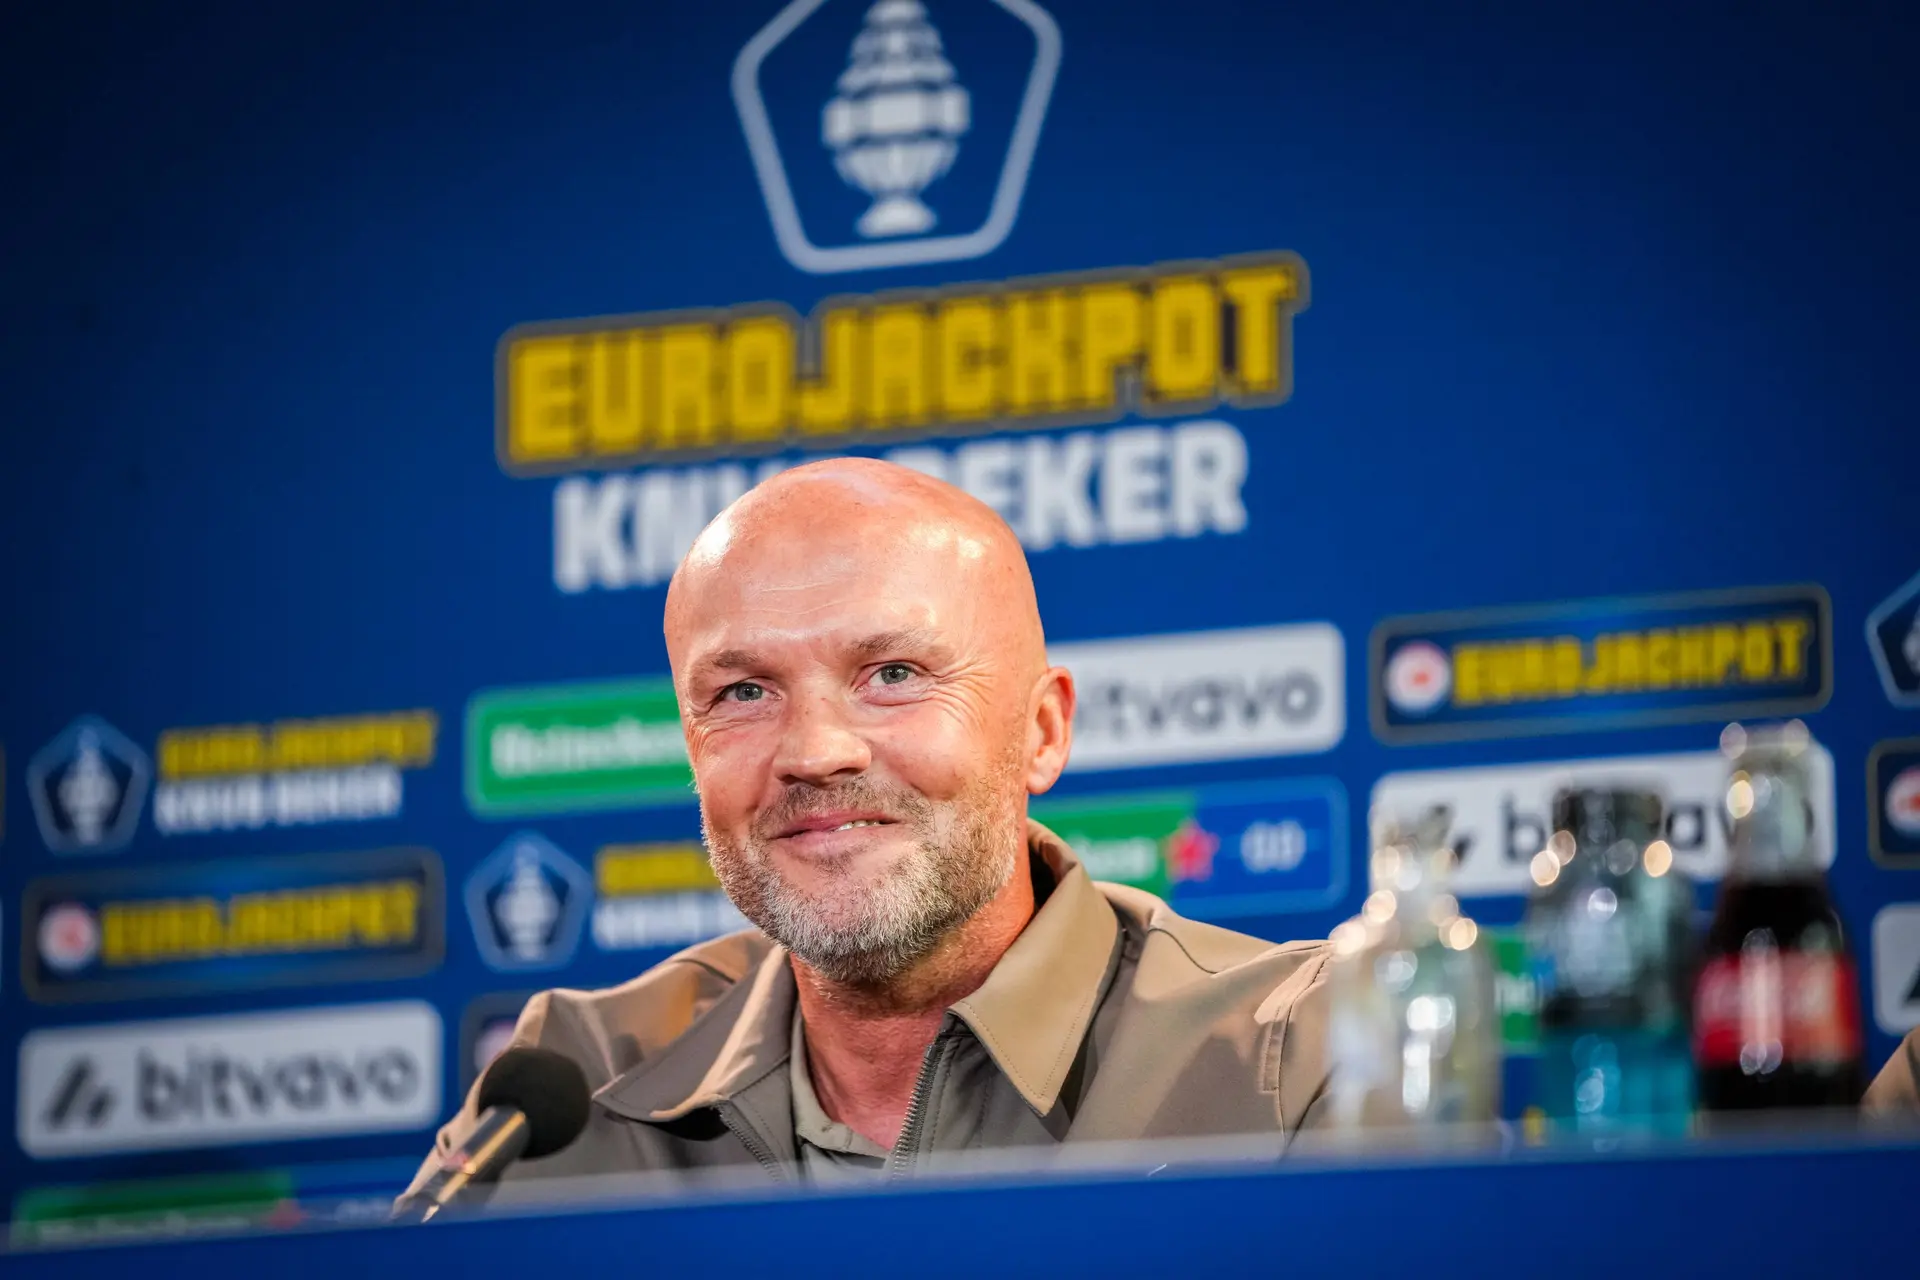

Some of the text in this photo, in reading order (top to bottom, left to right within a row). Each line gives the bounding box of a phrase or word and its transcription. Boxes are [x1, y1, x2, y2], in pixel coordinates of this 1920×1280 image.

[505, 262, 1301, 464] EUROJACKPOT
[886, 419, 1248, 552] EKER
[1453, 618, 1808, 706] EUROJACKPOT
[134, 1046, 420, 1121] bitvavo
